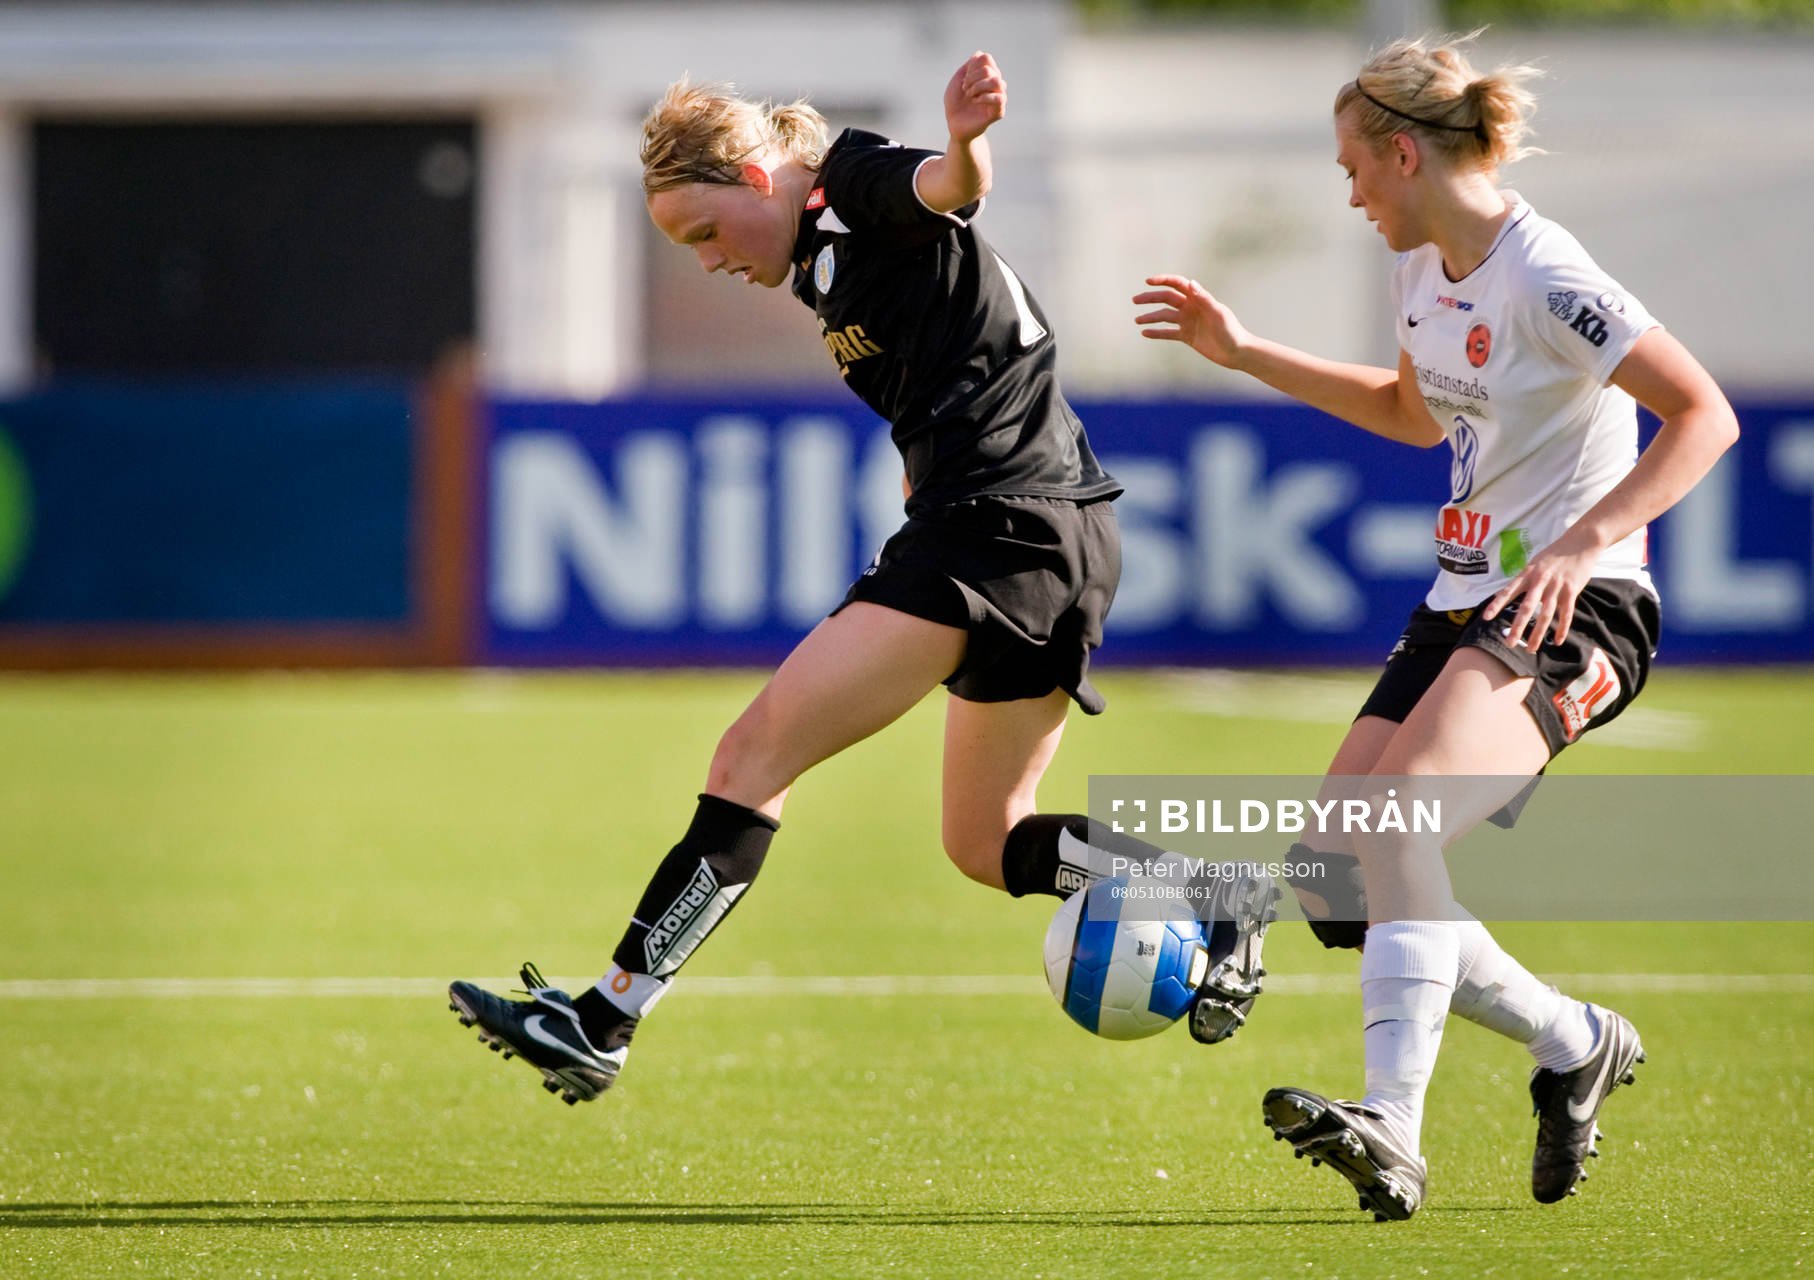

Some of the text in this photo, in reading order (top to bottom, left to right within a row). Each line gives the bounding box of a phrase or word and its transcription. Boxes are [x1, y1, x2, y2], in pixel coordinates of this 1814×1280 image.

[1570, 305, 1609, 347] Kb
[1435, 509, 1491, 549] AXI
[647, 871, 715, 962] ARROW
